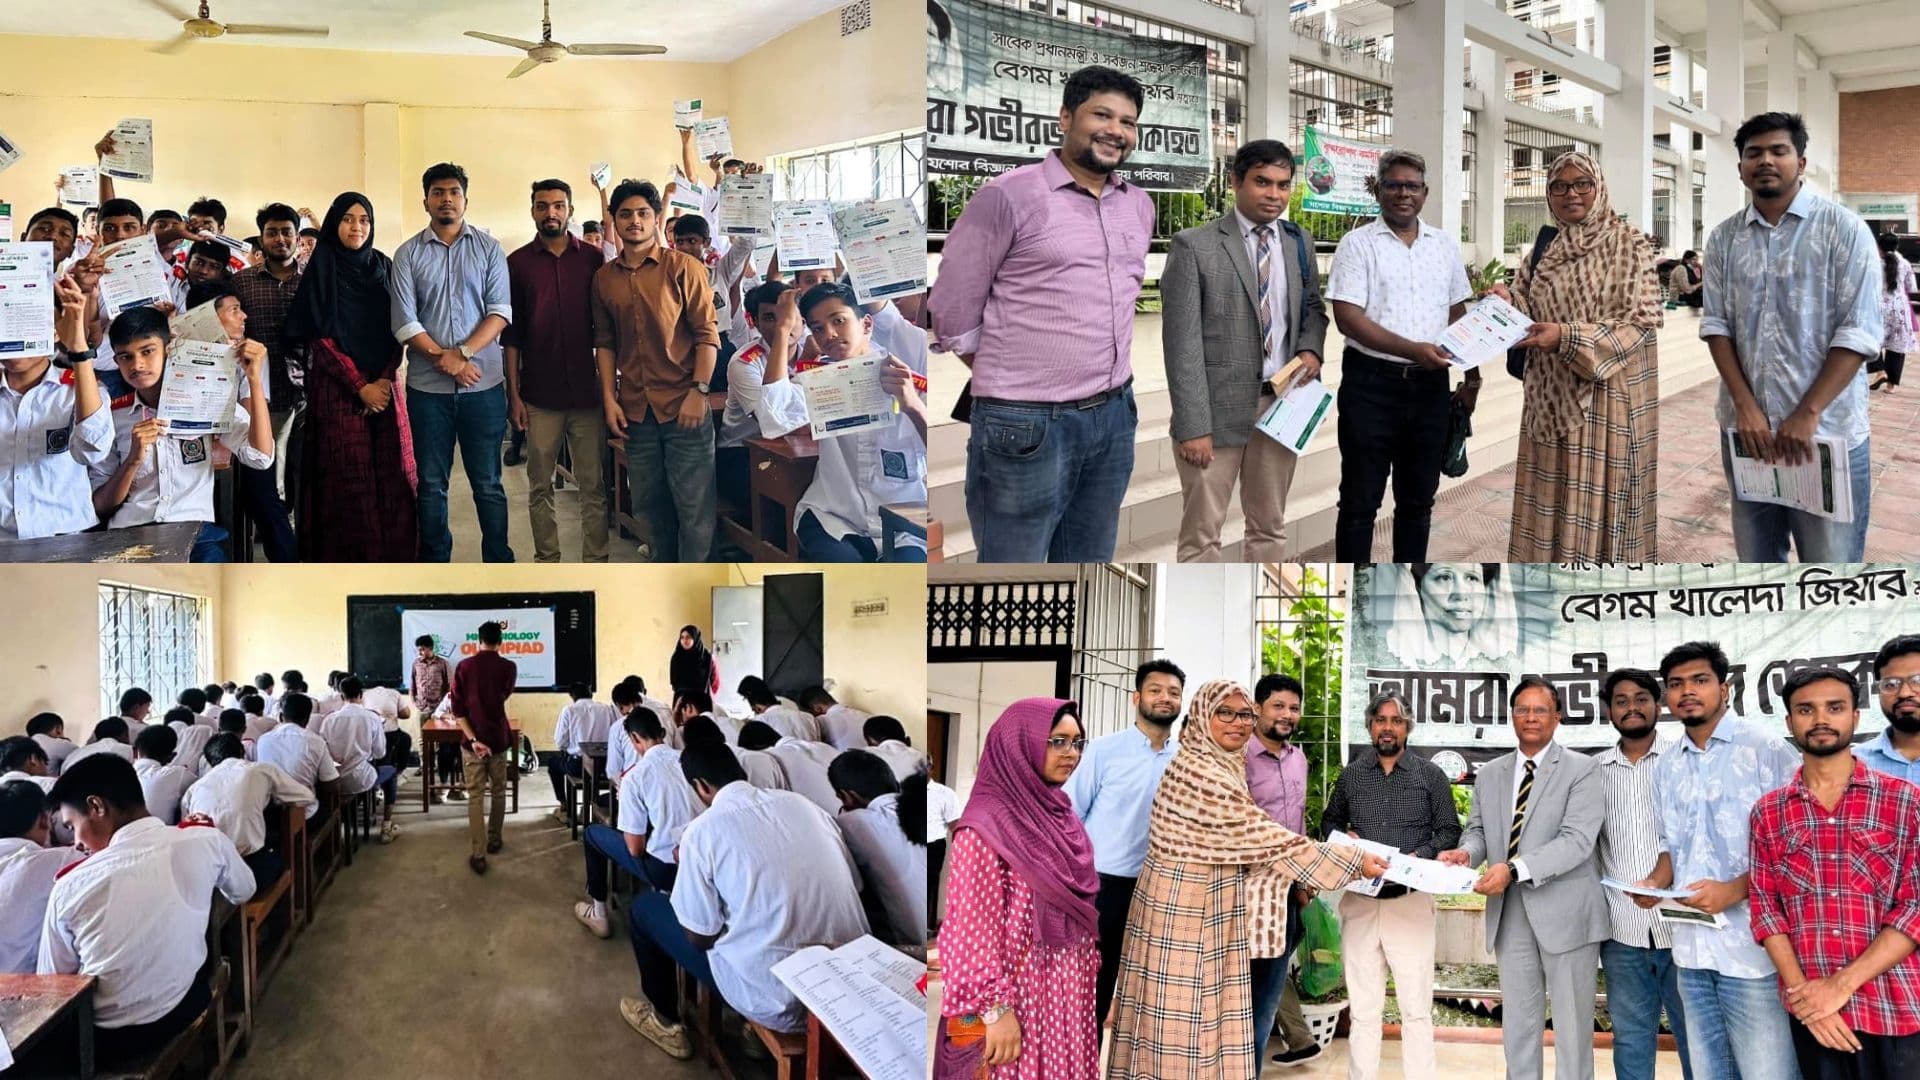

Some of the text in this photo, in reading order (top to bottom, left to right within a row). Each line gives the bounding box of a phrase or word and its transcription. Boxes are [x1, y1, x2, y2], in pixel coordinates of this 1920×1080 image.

[992, 32, 1032, 51] সাবেক
[1090, 52, 1099, 63] ও
[993, 61, 1053, 86] বেগম
[928, 158, 969, 171] যশোর
[1561, 590, 1658, 623] বেগম
[1669, 583, 1786, 617] খালেদা
[1796, 568, 1908, 610] জিয়ার
